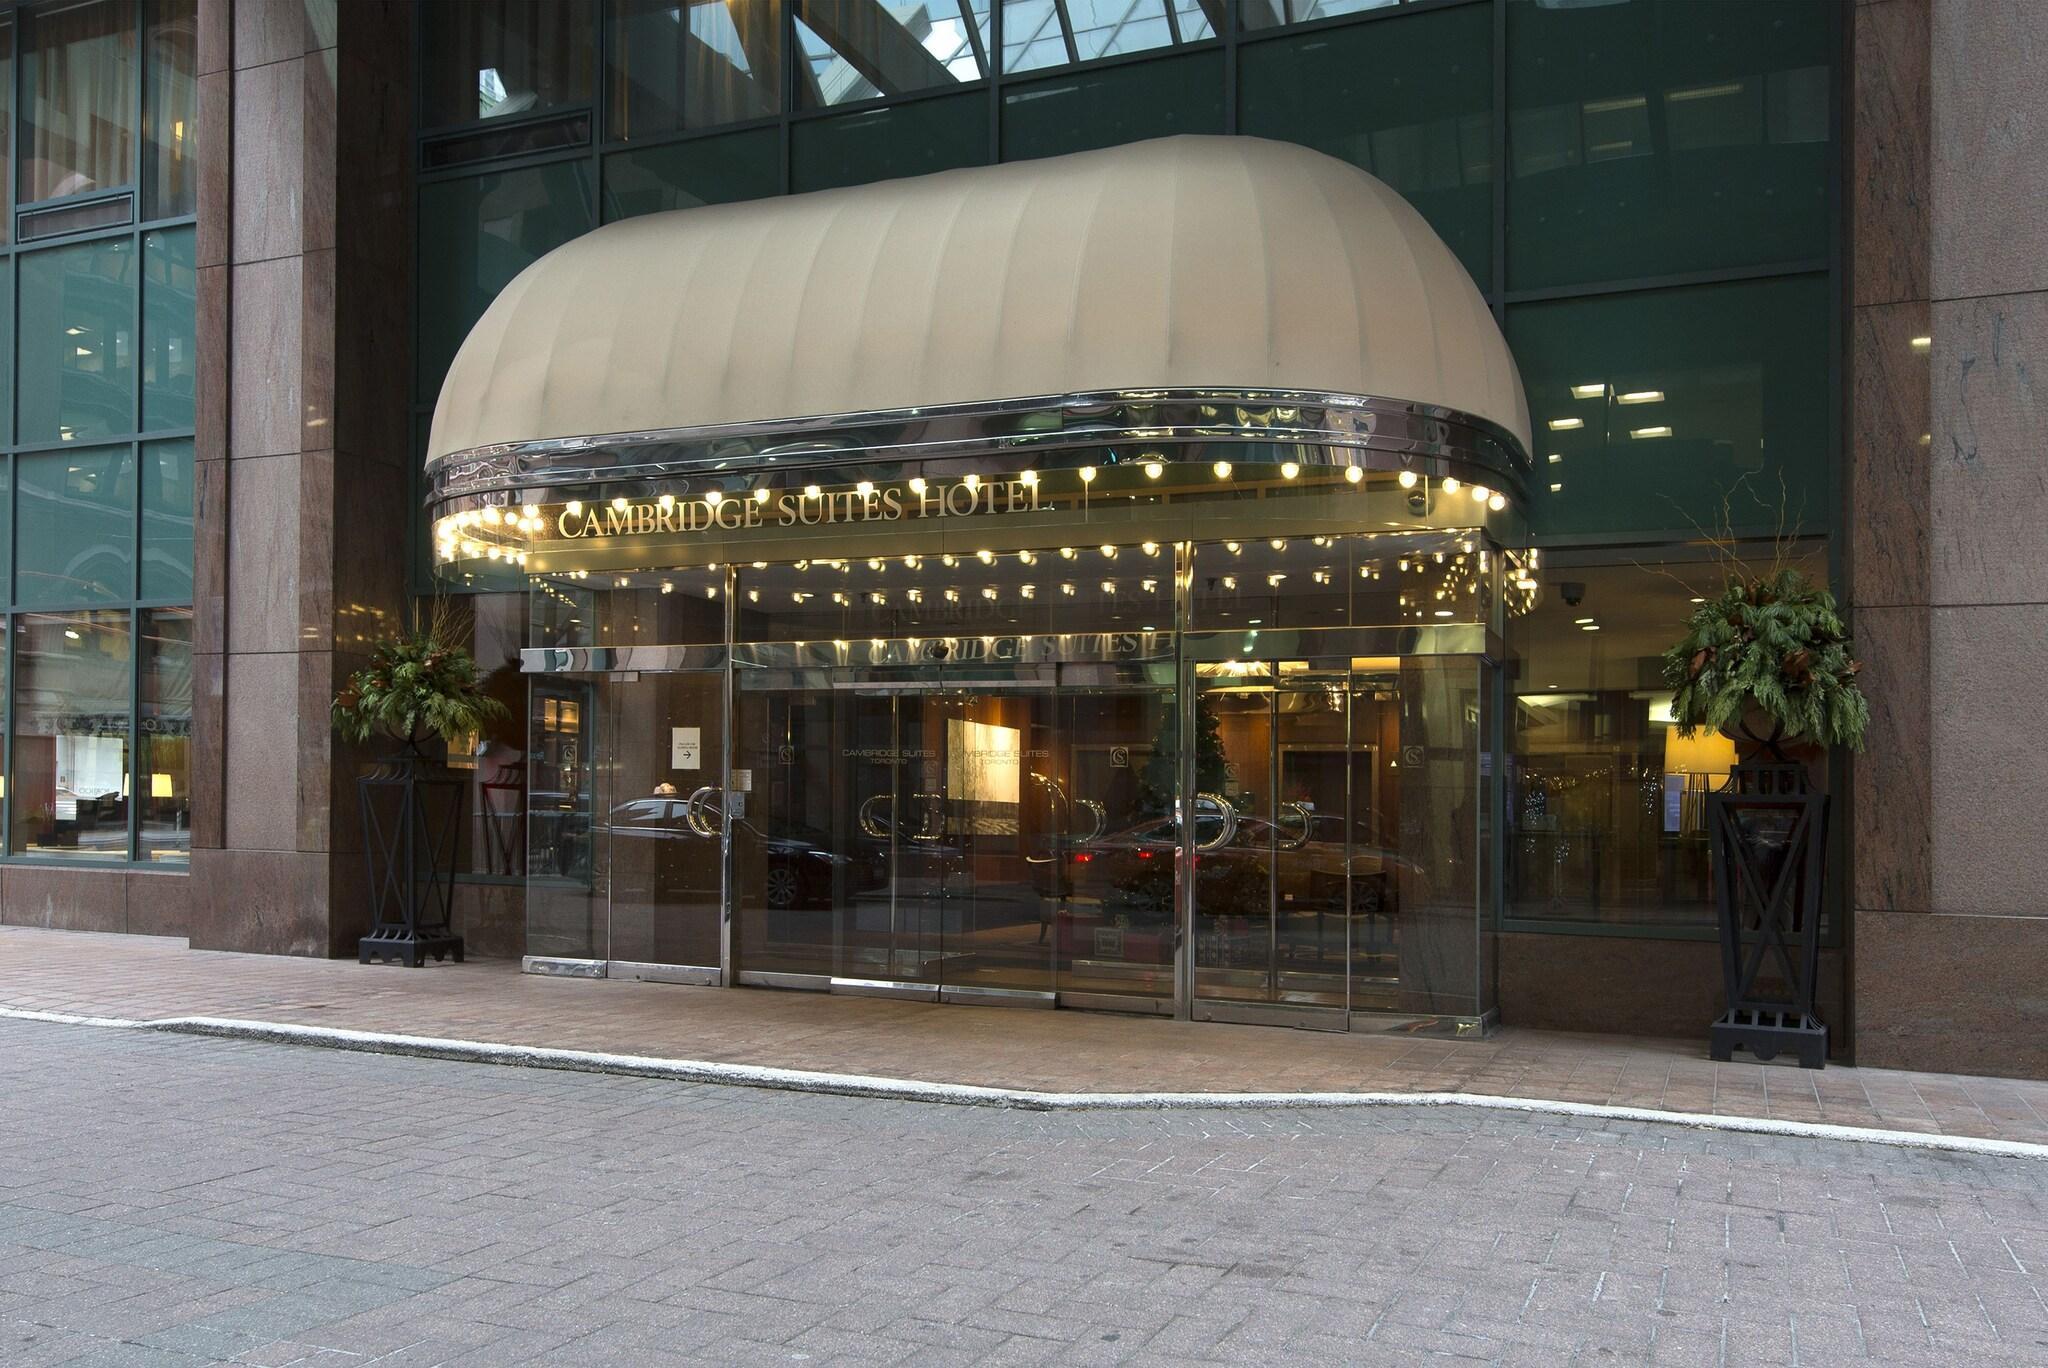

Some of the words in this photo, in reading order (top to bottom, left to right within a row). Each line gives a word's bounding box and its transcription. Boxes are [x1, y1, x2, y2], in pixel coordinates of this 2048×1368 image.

[558, 497, 763, 539] CAMBRIDGE
[778, 487, 903, 527] SUITES
[917, 478, 1053, 519] HOTEL
[842, 749, 898, 758] CAMBRIDGE
[902, 749, 936, 757] SUITES
